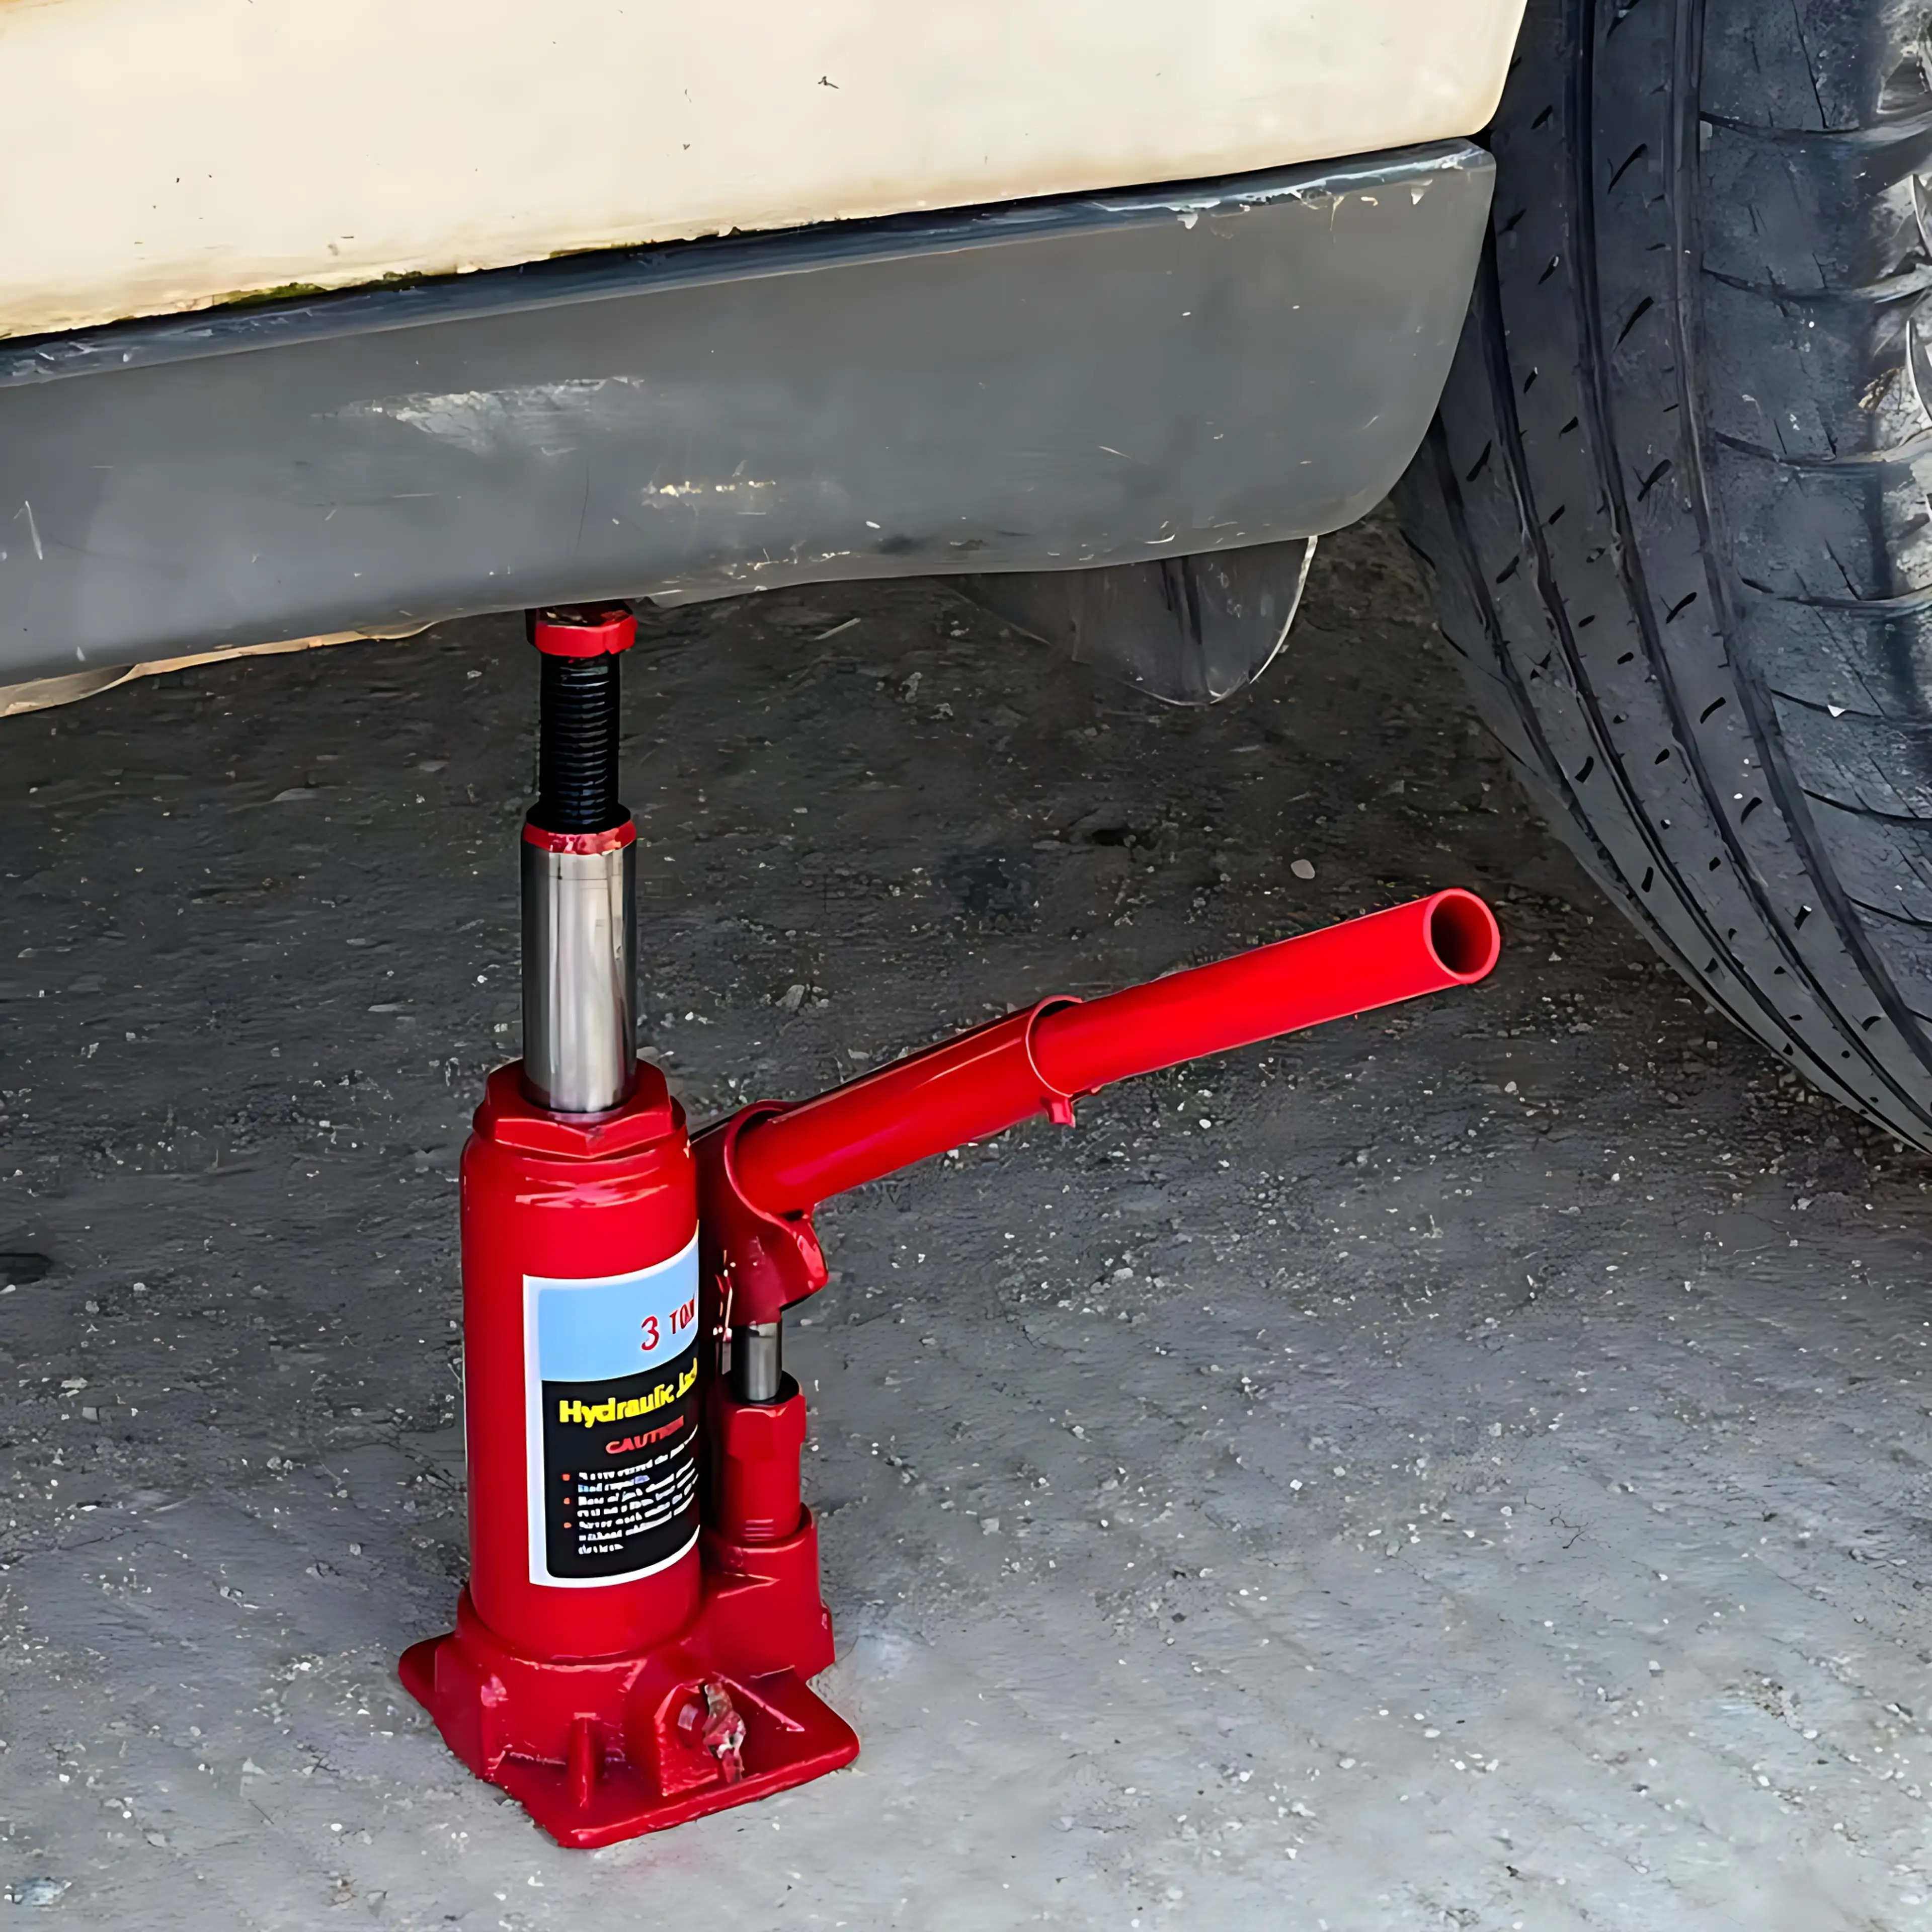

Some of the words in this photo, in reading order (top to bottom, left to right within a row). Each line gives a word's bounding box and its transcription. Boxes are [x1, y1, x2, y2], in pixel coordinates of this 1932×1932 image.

[641, 1315, 660, 1351] 3
[559, 1383, 675, 1428] Hydraulic
[605, 1415, 684, 1455] CAUTI
